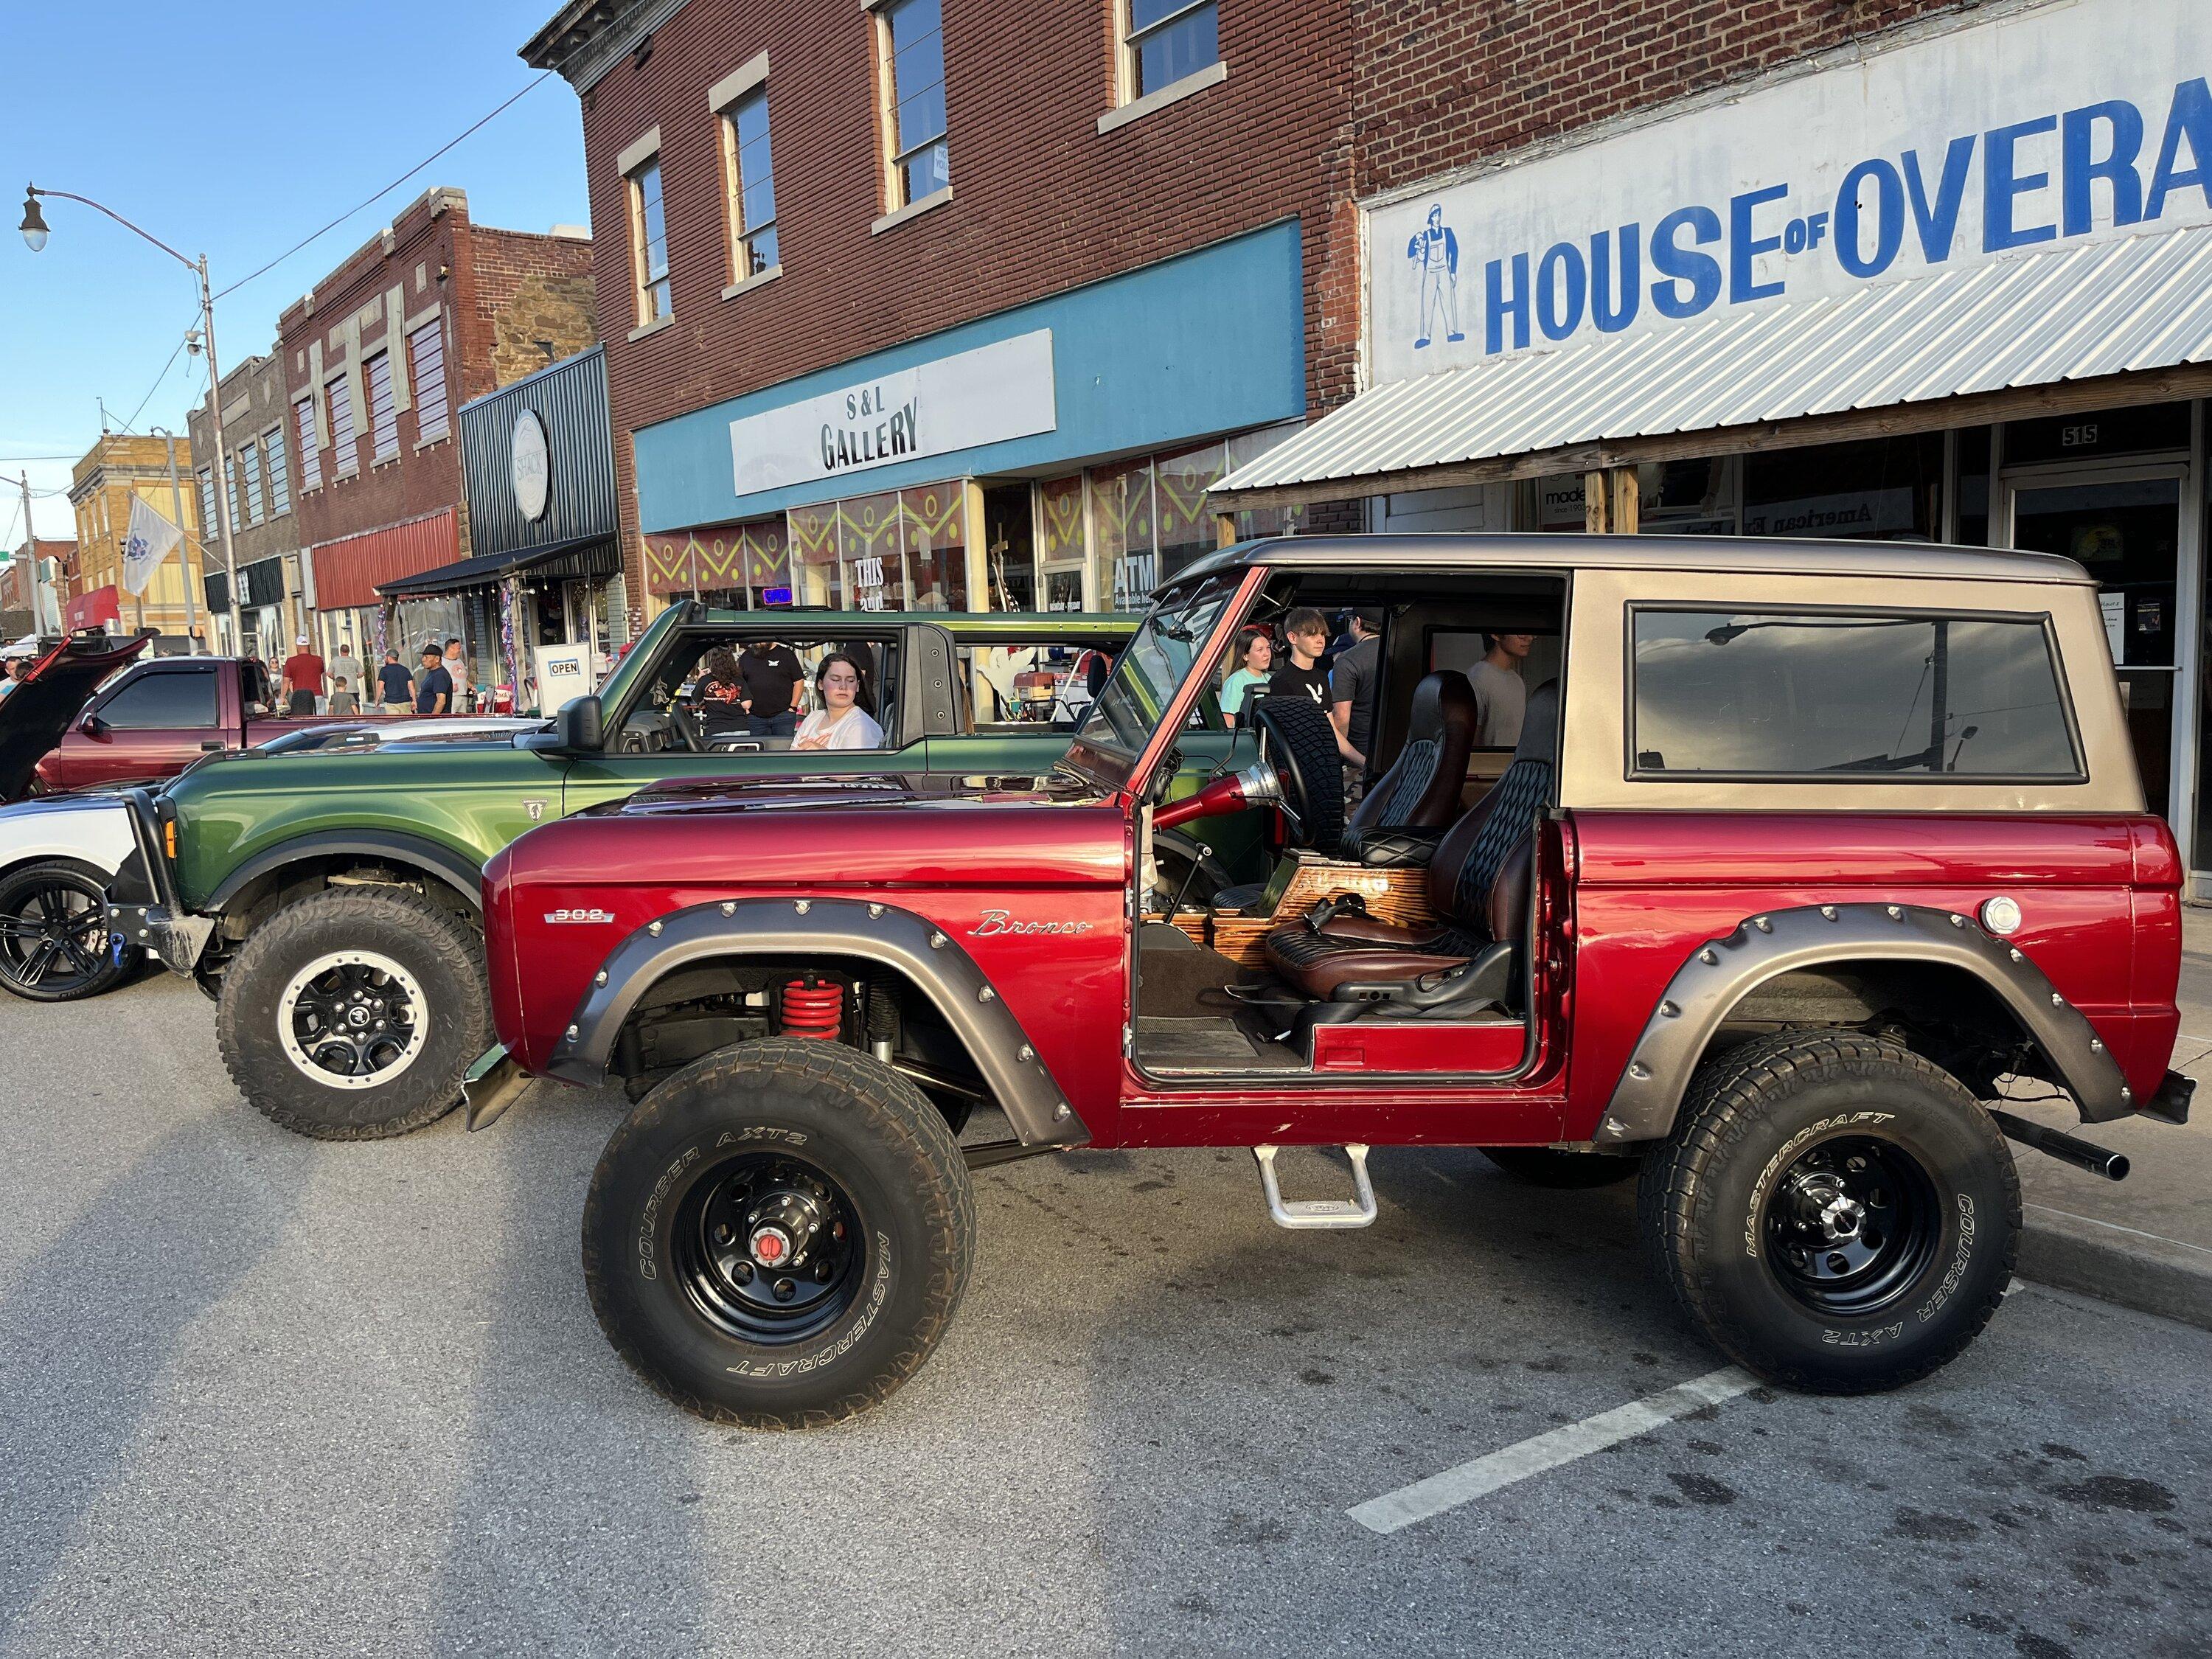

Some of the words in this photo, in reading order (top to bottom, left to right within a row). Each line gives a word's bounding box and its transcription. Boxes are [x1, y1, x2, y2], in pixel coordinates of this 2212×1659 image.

[1484, 181, 1789, 356] HOUSE
[1784, 210, 1829, 255] OF
[1833, 76, 2212, 279] OVERA
[846, 393, 857, 420] S
[860, 389, 872, 417] &
[875, 386, 885, 413] L
[821, 395, 917, 471] GALLERY
[2064, 426, 2096, 445] 515
[517, 452, 543, 481] SHACK
[1545, 487, 1586, 505] made
[855, 556, 884, 588] THIS
[1114, 554, 1155, 594] ATM
[859, 591, 884, 611] and
[552, 663, 577, 674] OPEN
[555, 908, 604, 921] 302
[966, 908, 1094, 936] Bronco
[1745, 1110, 1896, 1258] MASTERCRAFT
[638, 1145, 701, 1281] COURSER
[715, 1126, 808, 1148] AXT2
[1916, 1192, 1976, 1324] COURSER
[726, 1230, 891, 1377] MASTERCRAFT
[1821, 1321, 1904, 1346] AXT2
